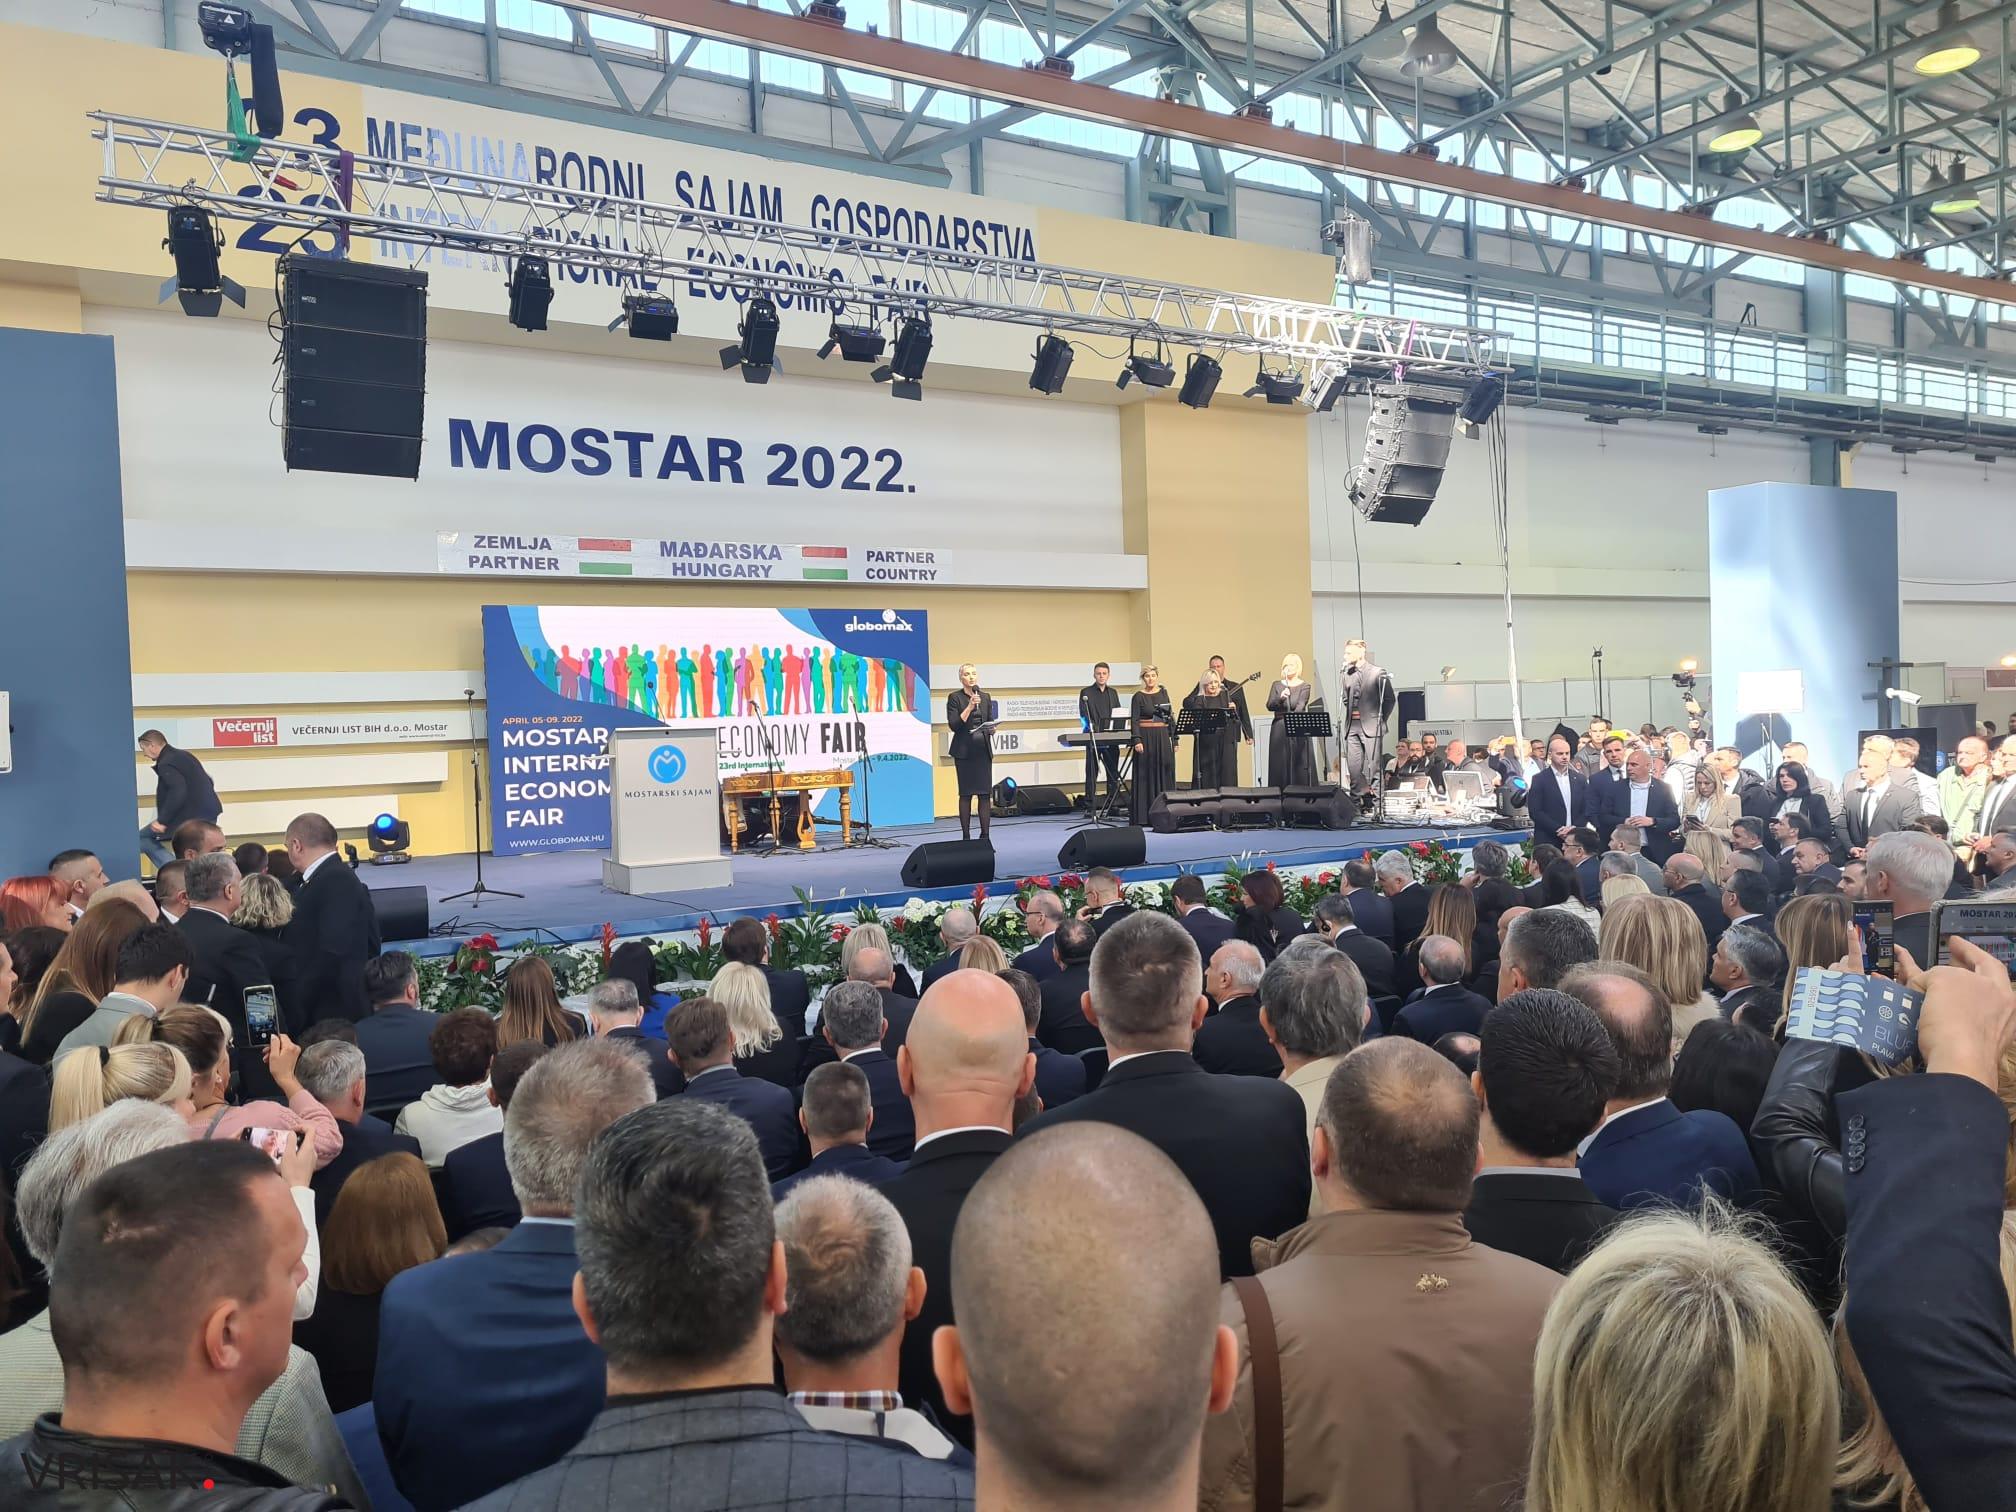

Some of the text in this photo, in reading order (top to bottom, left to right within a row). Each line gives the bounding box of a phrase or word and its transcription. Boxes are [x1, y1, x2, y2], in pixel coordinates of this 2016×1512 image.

[675, 170, 783, 234] SAJAM
[810, 193, 1039, 275] GOSPODARSTVA
[448, 417, 916, 494] MOSTAR 2022.
[473, 534, 552, 551] ZEMLJA
[659, 540, 783, 562] MAĐARSKA
[468, 554, 560, 572] PARTNER
[866, 550, 936, 565] PARTNER
[672, 562, 773, 579] HUNGARY
[865, 567, 938, 582] COUNTRY
[844, 615, 914, 632] globomax
[216, 718, 274, 734] Večernji
[292, 722, 448, 735] VEČERNJI LIST BIH d.o.o. Mostar
[502, 716, 530, 725] APRIL
[562, 715, 584, 723] 2022
[253, 731, 275, 744] list
[503, 727, 609, 748] MOSTAR
[718, 721, 866, 759] ECONOMY FAIR
[718, 761, 737, 770] 23rd
[624, 788, 712, 799] MOSTARSKI SAJAM
[506, 807, 564, 828] FAIR
[509, 834, 605, 848] WWW.GLOBOMAX.HU
[1960, 909, 2001, 919] MOSTAR
[1871, 1042, 1896, 1060] PLAVA
